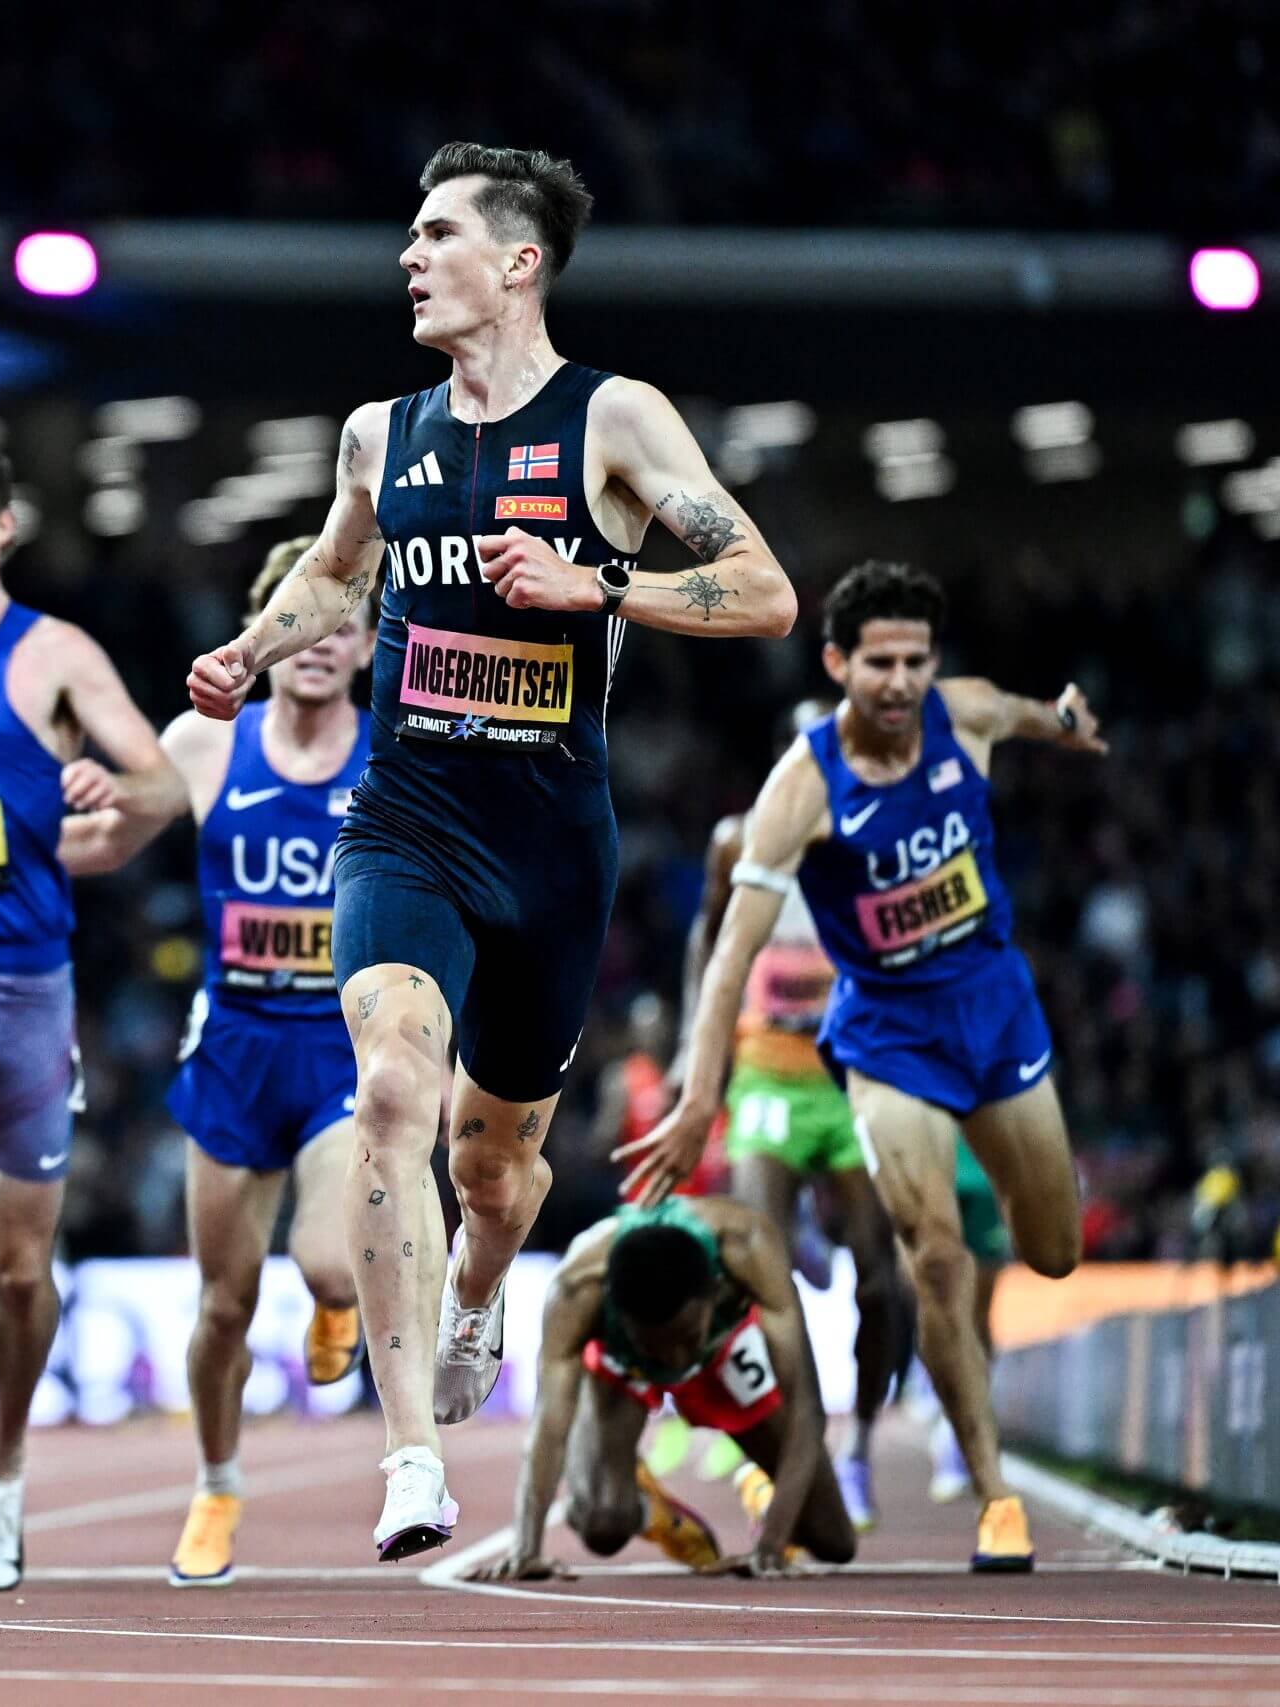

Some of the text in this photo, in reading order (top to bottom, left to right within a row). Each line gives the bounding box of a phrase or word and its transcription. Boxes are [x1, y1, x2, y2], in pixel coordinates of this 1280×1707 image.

[520, 502, 562, 513] EXTRA
[387, 534, 583, 592] NORY
[407, 641, 569, 710] INGEBRIGTSEN
[408, 713, 557, 743] ULTIMATE BUDAPEST 26
[867, 811, 976, 890] USA
[239, 915, 334, 959] WOLF
[731, 1347, 766, 1390] 5
